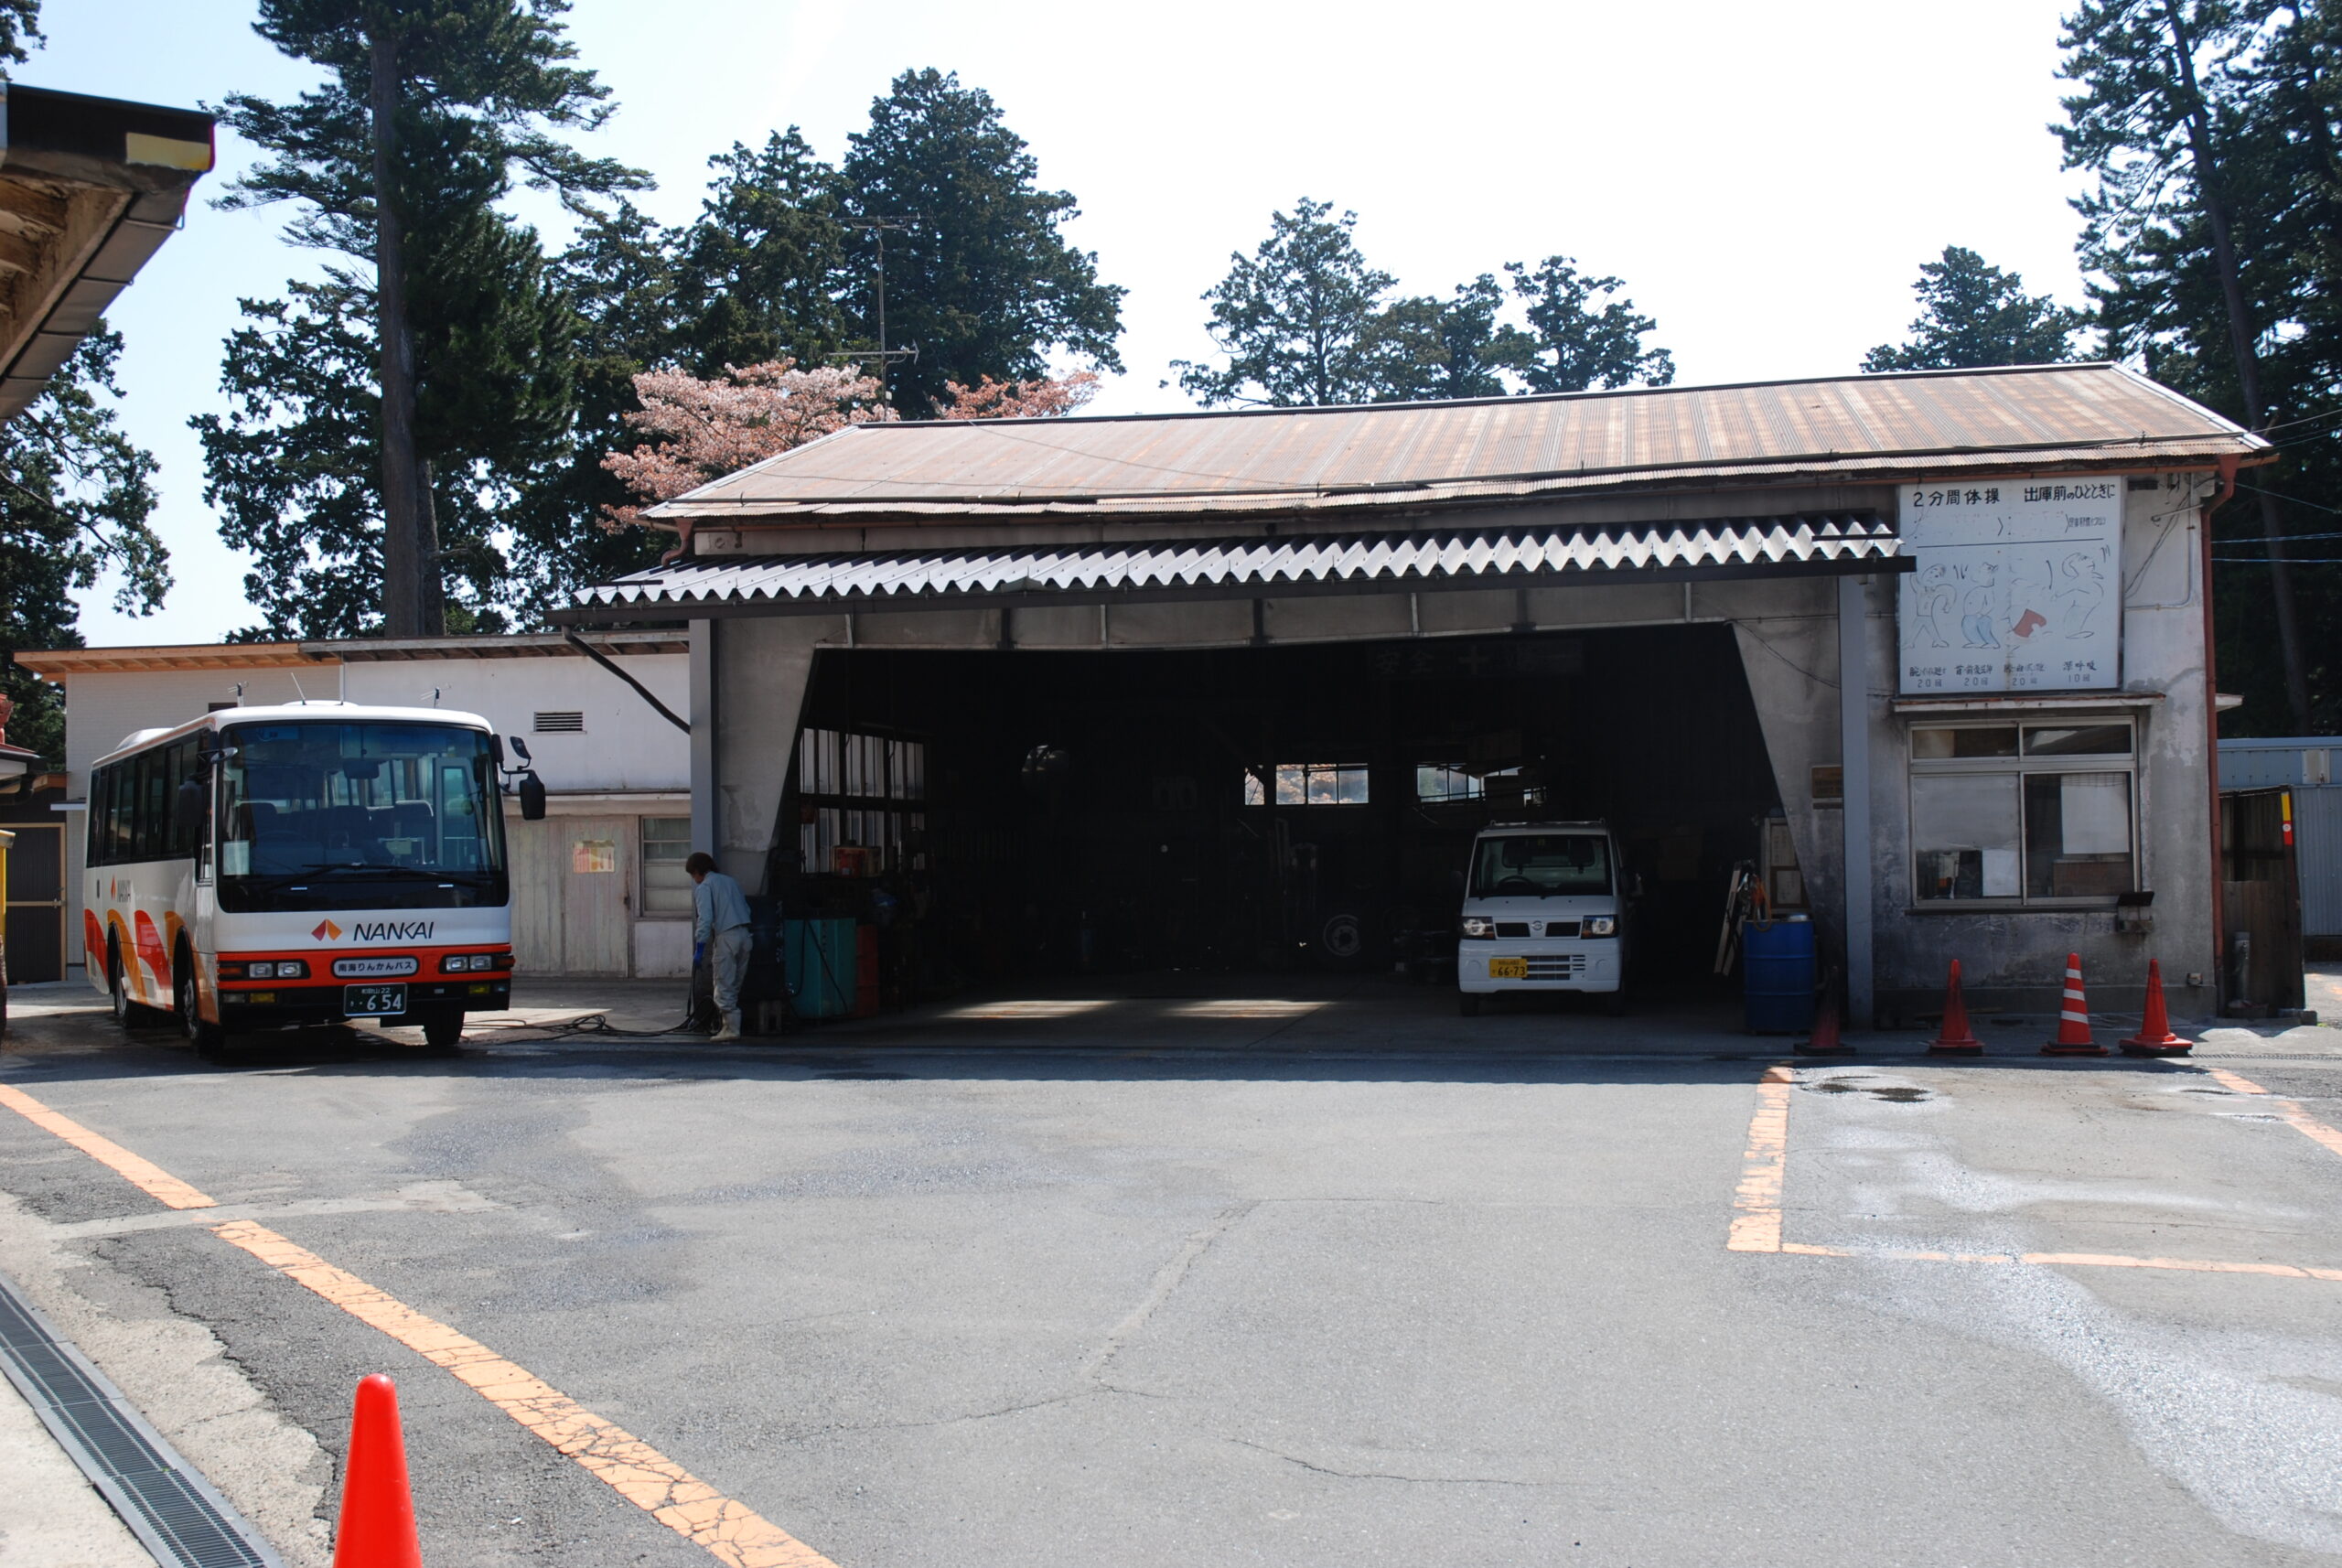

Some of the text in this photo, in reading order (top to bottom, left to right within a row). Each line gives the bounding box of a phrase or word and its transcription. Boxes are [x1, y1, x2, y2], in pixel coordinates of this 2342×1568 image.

[1913, 484, 2116, 508] 2分間体操 出庫前のひとときに
[353, 921, 435, 941] NANKAI
[338, 961, 413, 972] 南海りんかんバス
